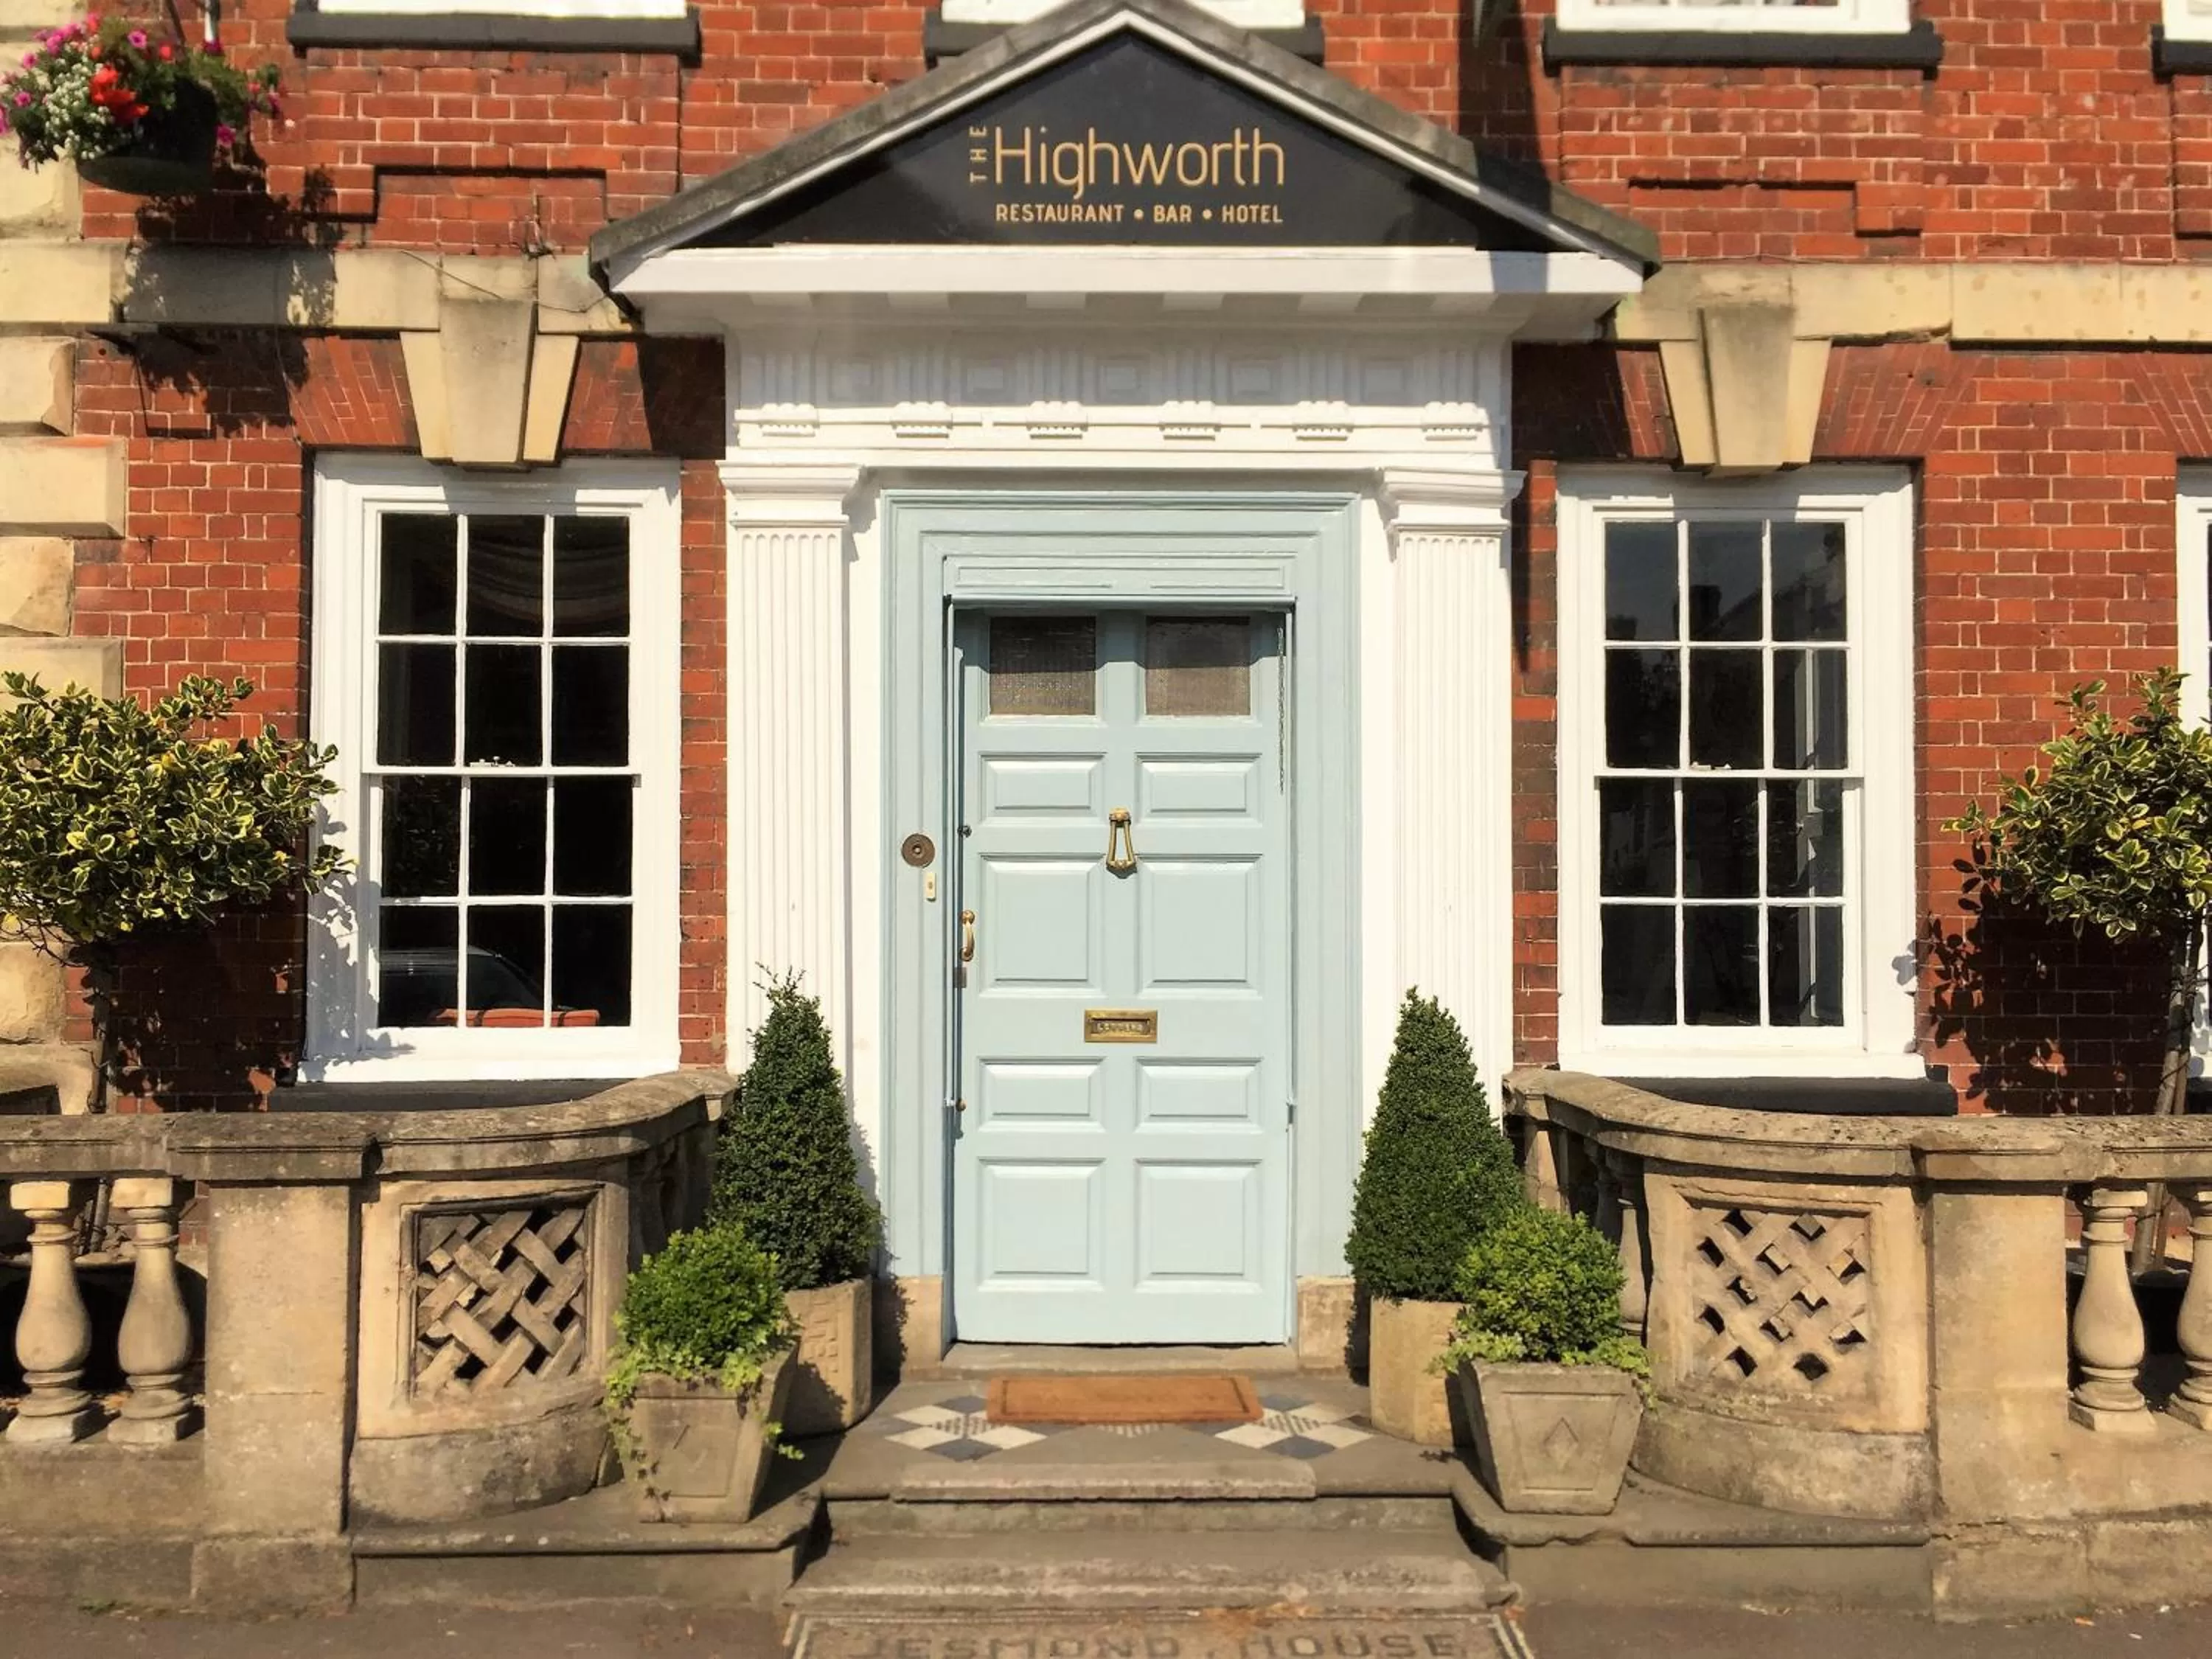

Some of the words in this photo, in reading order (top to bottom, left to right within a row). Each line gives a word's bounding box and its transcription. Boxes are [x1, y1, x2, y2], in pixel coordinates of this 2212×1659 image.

[970, 125, 988, 183] THE
[995, 126, 1284, 199] Highworth
[995, 204, 1124, 223] RESTAURANT
[1153, 204, 1192, 223] BAR
[1222, 204, 1283, 223] HOTEL
